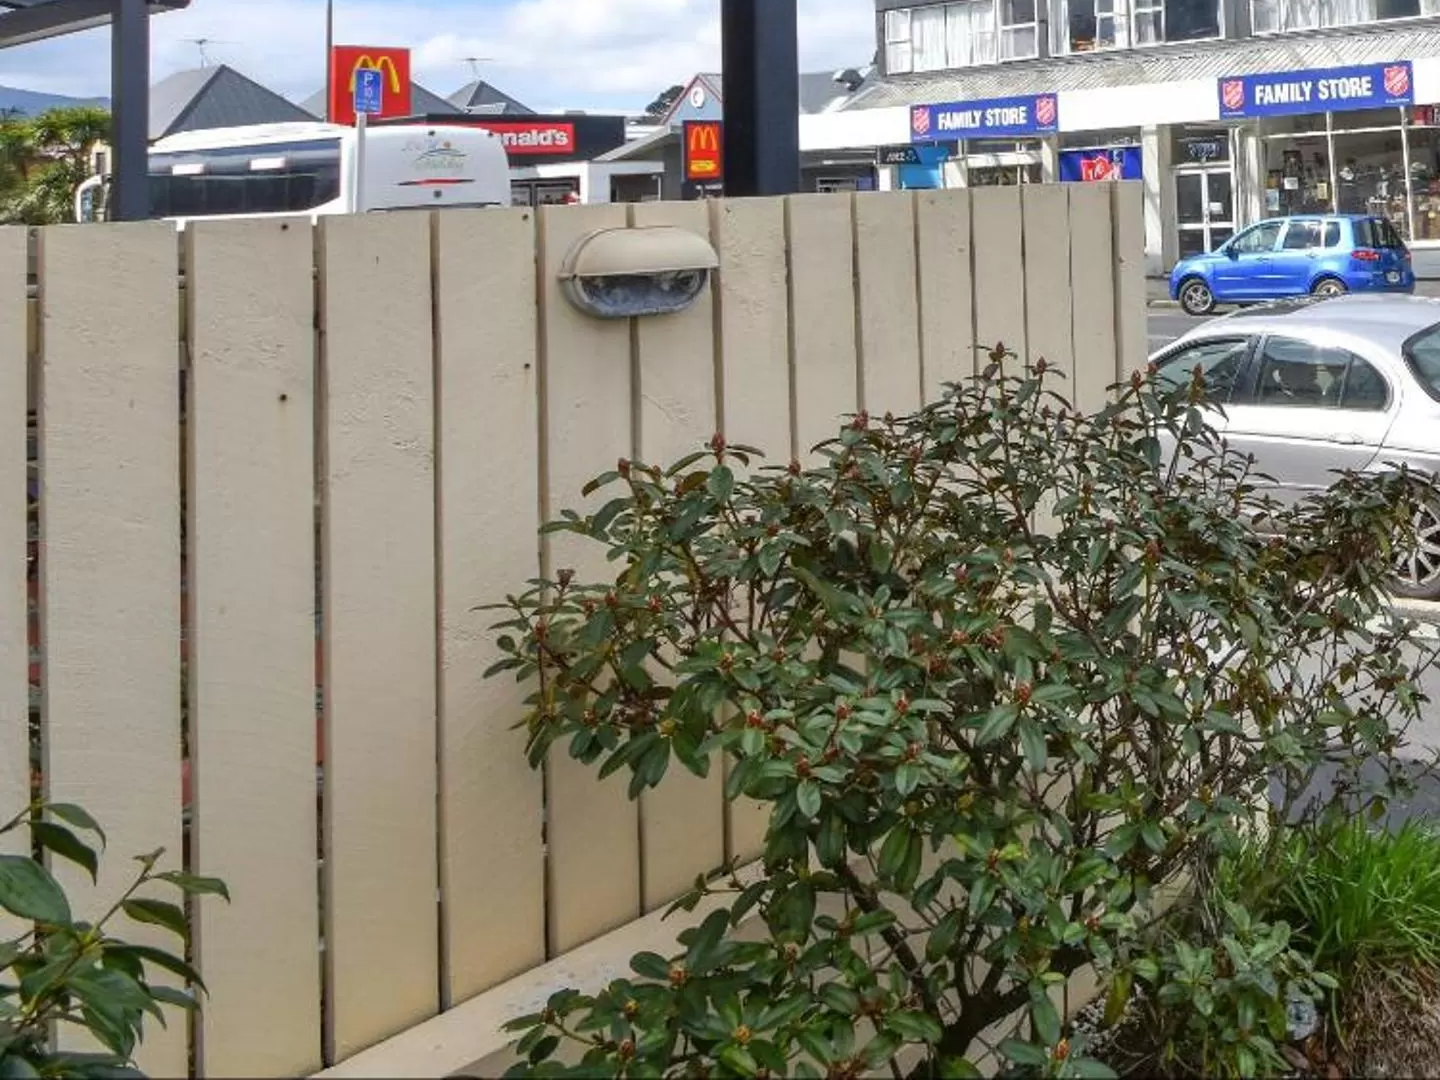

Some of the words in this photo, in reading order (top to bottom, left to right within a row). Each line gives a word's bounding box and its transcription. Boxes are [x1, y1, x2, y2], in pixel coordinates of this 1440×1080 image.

[1255, 81, 1312, 105] FAMILY
[1318, 76, 1373, 101] STORE
[938, 110, 981, 130] FAMILY
[985, 106, 1027, 127] STORE
[502, 128, 568, 146] nald's
